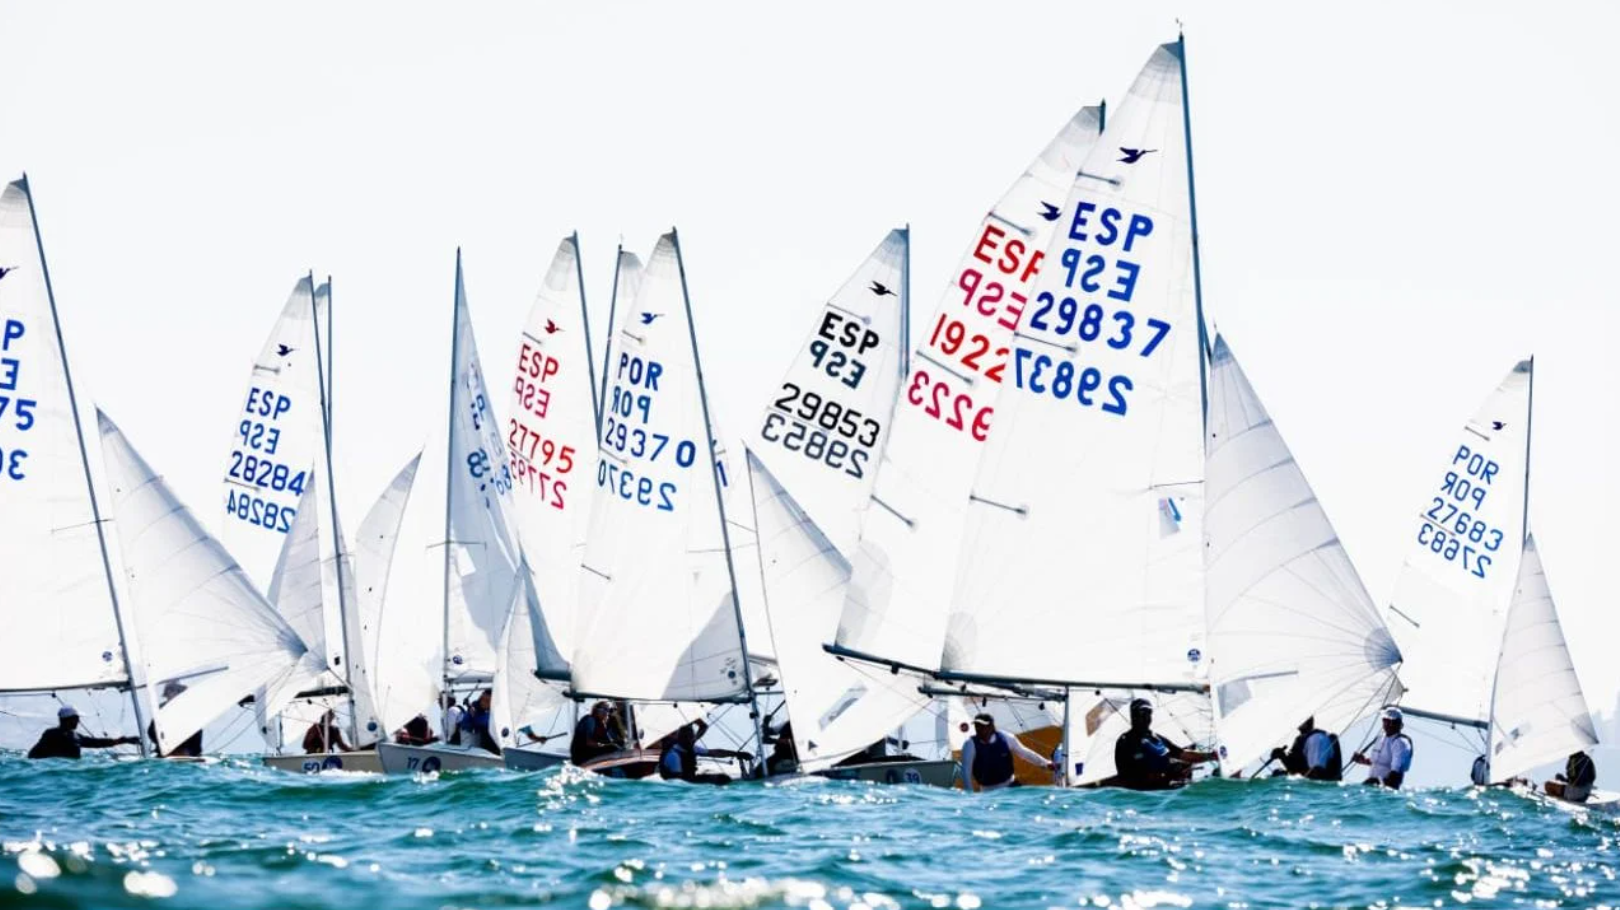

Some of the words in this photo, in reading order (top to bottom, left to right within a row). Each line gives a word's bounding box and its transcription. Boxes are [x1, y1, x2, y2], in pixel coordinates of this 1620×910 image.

[1068, 201, 1153, 252] ESP
[818, 311, 880, 355] ESP
[1029, 291, 1171, 358] 29837
[518, 343, 559, 383] ESP
[618, 352, 663, 391] POR
[246, 387, 291, 420] ESP
[774, 382, 880, 448] 29853
[510, 418, 575, 474] 27795
[605, 417, 696, 468] 29370
[1453, 445, 1499, 485] POR
[229, 451, 306, 496] 28284
[1427, 497, 1504, 551] 27683
